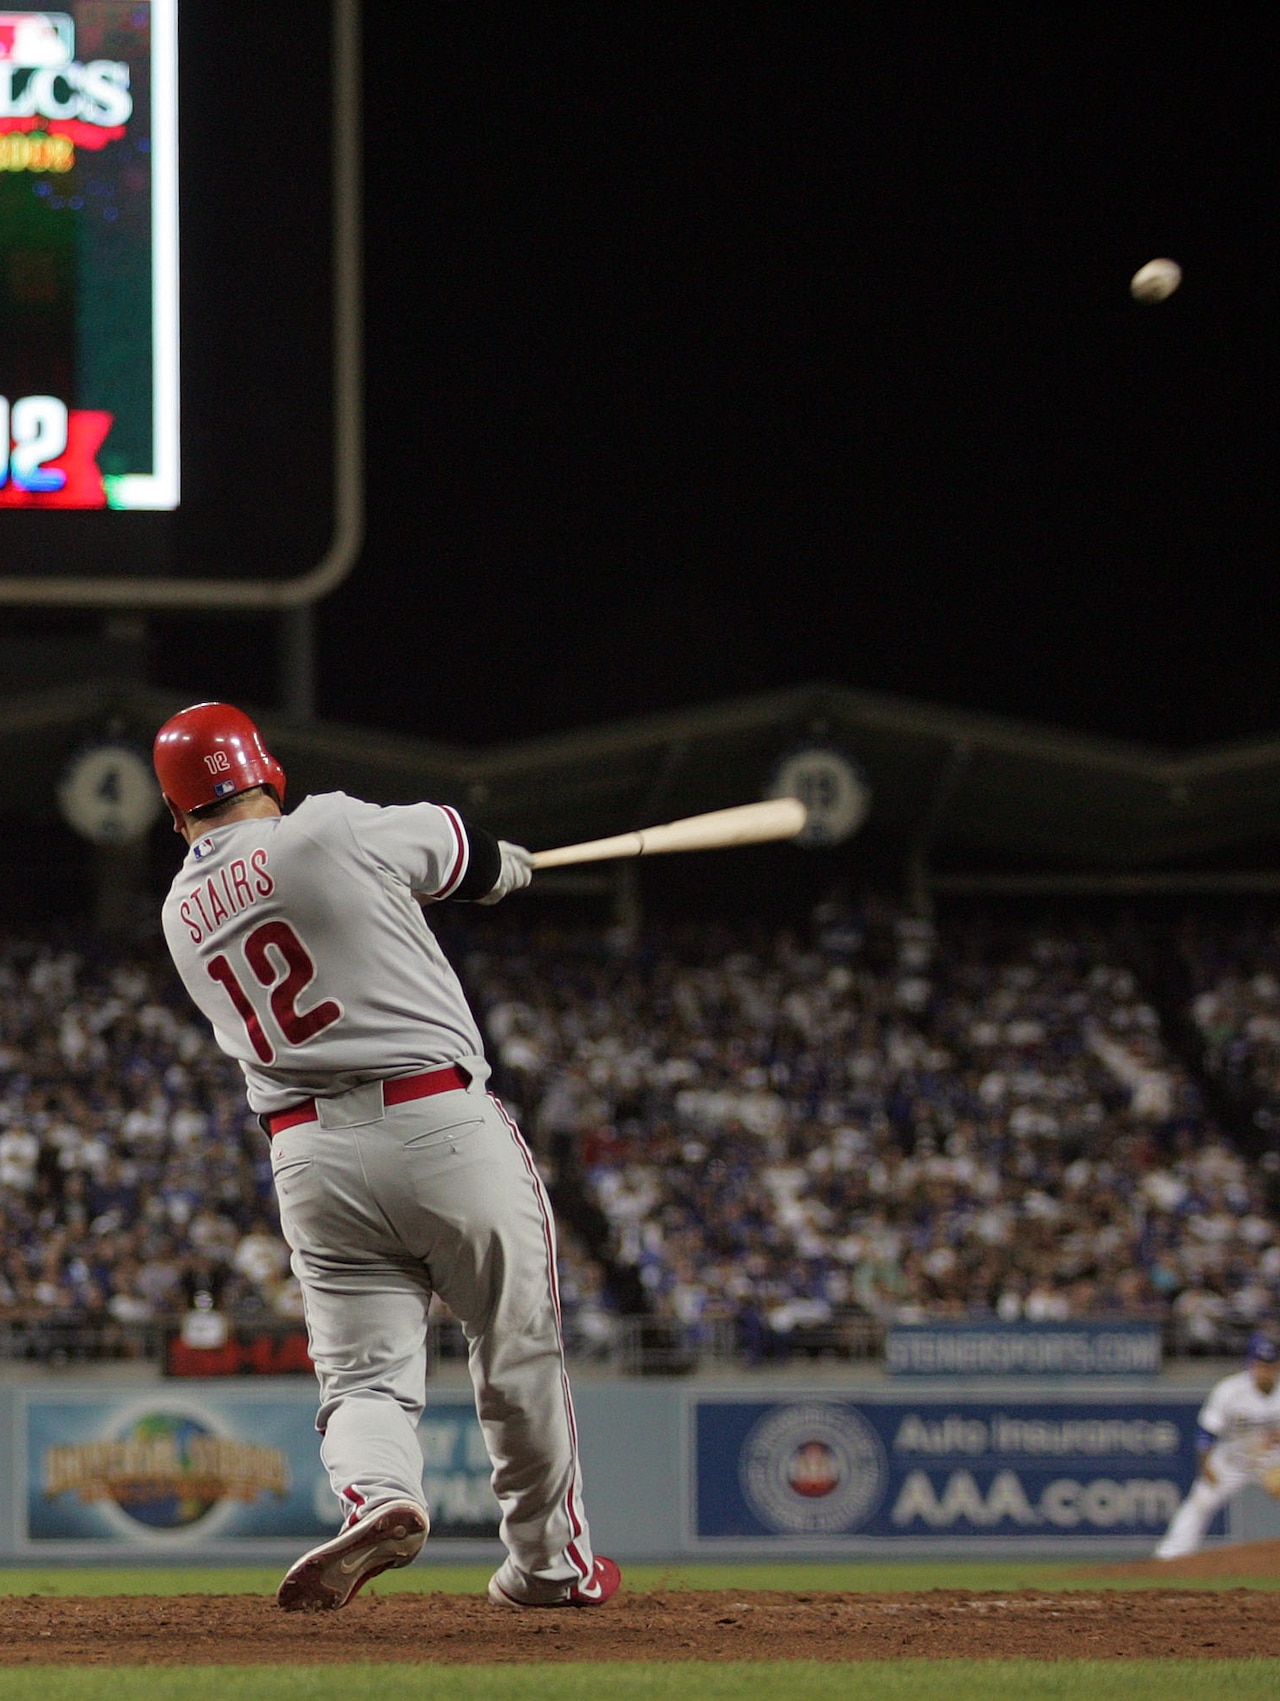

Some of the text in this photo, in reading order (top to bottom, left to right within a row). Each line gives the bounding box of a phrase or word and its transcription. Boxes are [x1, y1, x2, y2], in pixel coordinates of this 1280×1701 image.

[203, 750, 232, 776] 12
[179, 847, 276, 945] STAIRS
[203, 917, 345, 1066] 12
[893, 1412, 1181, 1452] Auto Insurance
[889, 1467, 1184, 1529] AAA.com
